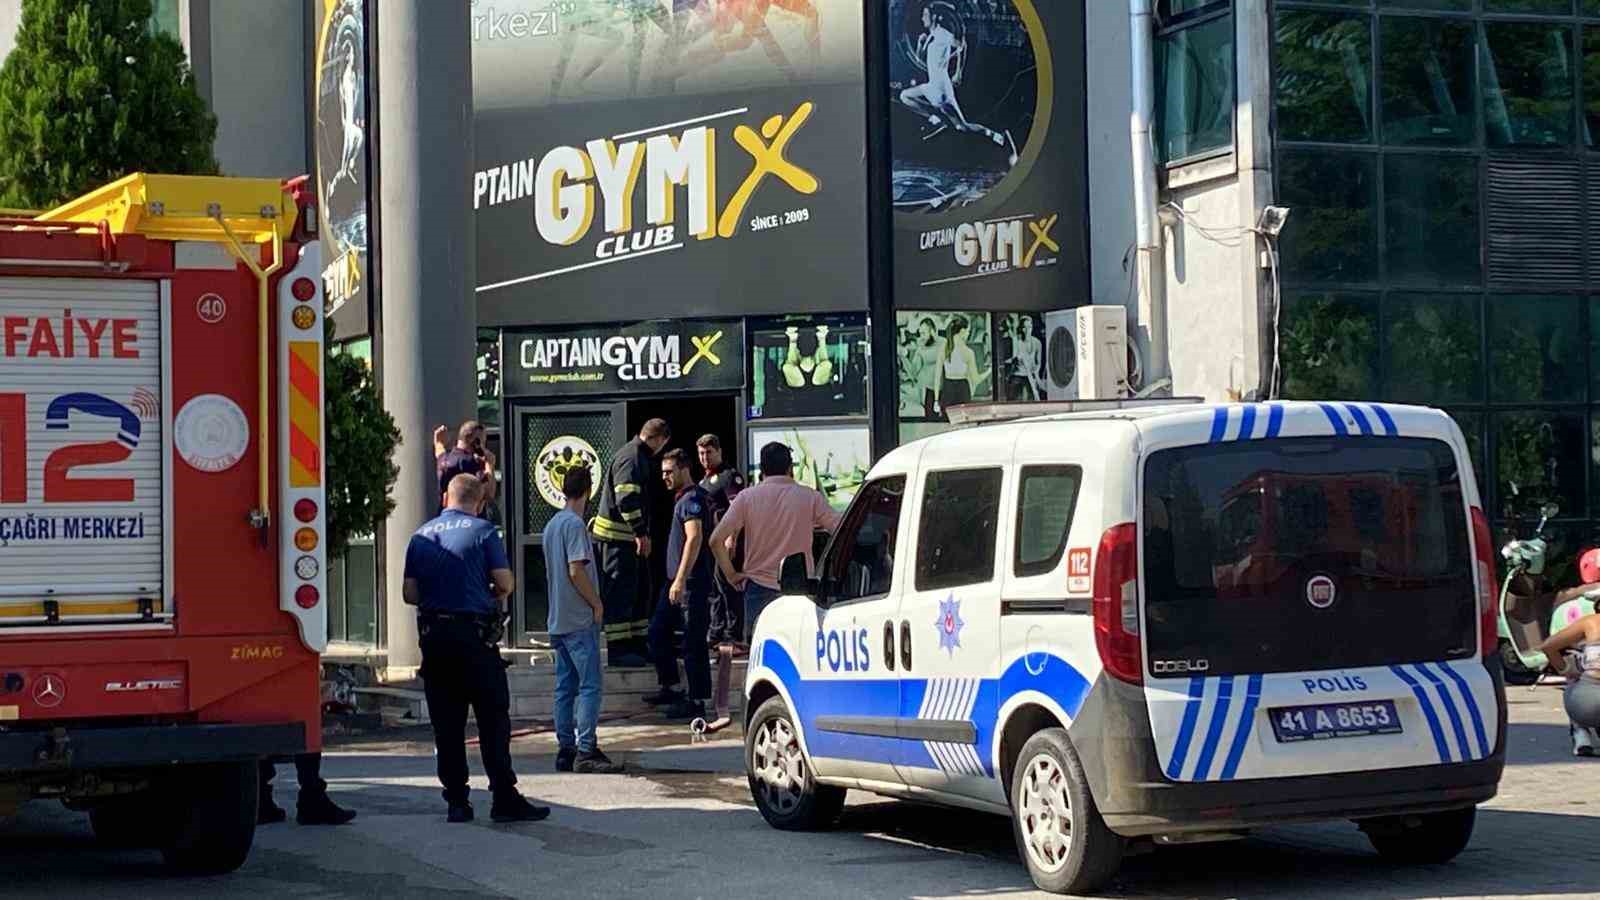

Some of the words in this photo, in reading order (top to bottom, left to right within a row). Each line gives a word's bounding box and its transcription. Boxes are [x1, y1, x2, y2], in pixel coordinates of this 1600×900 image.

[474, 158, 535, 209] PTAIN
[535, 126, 716, 246] GYM
[784, 208, 809, 224] 2009
[595, 225, 675, 258] CLUB
[920, 227, 955, 250] CAPTAIN
[954, 220, 1024, 268] GYM
[977, 261, 1008, 273] CLUB
[200, 299, 222, 316] 40
[4, 308, 139, 358] FAİYE
[520, 337, 600, 368] CAPTAIN
[601, 335, 681, 366] GYM
[617, 363, 682, 381] CLUB
[0, 511, 56, 547] ÇAĞRI
[64, 511, 144, 538] MERKEZİ
[1070, 551, 1089, 574] 112
[816, 615, 870, 672] POLİS
[1281, 711, 1308, 731] 41
[1315, 710, 1334, 729] A
[1336, 705, 1391, 727] 8653
